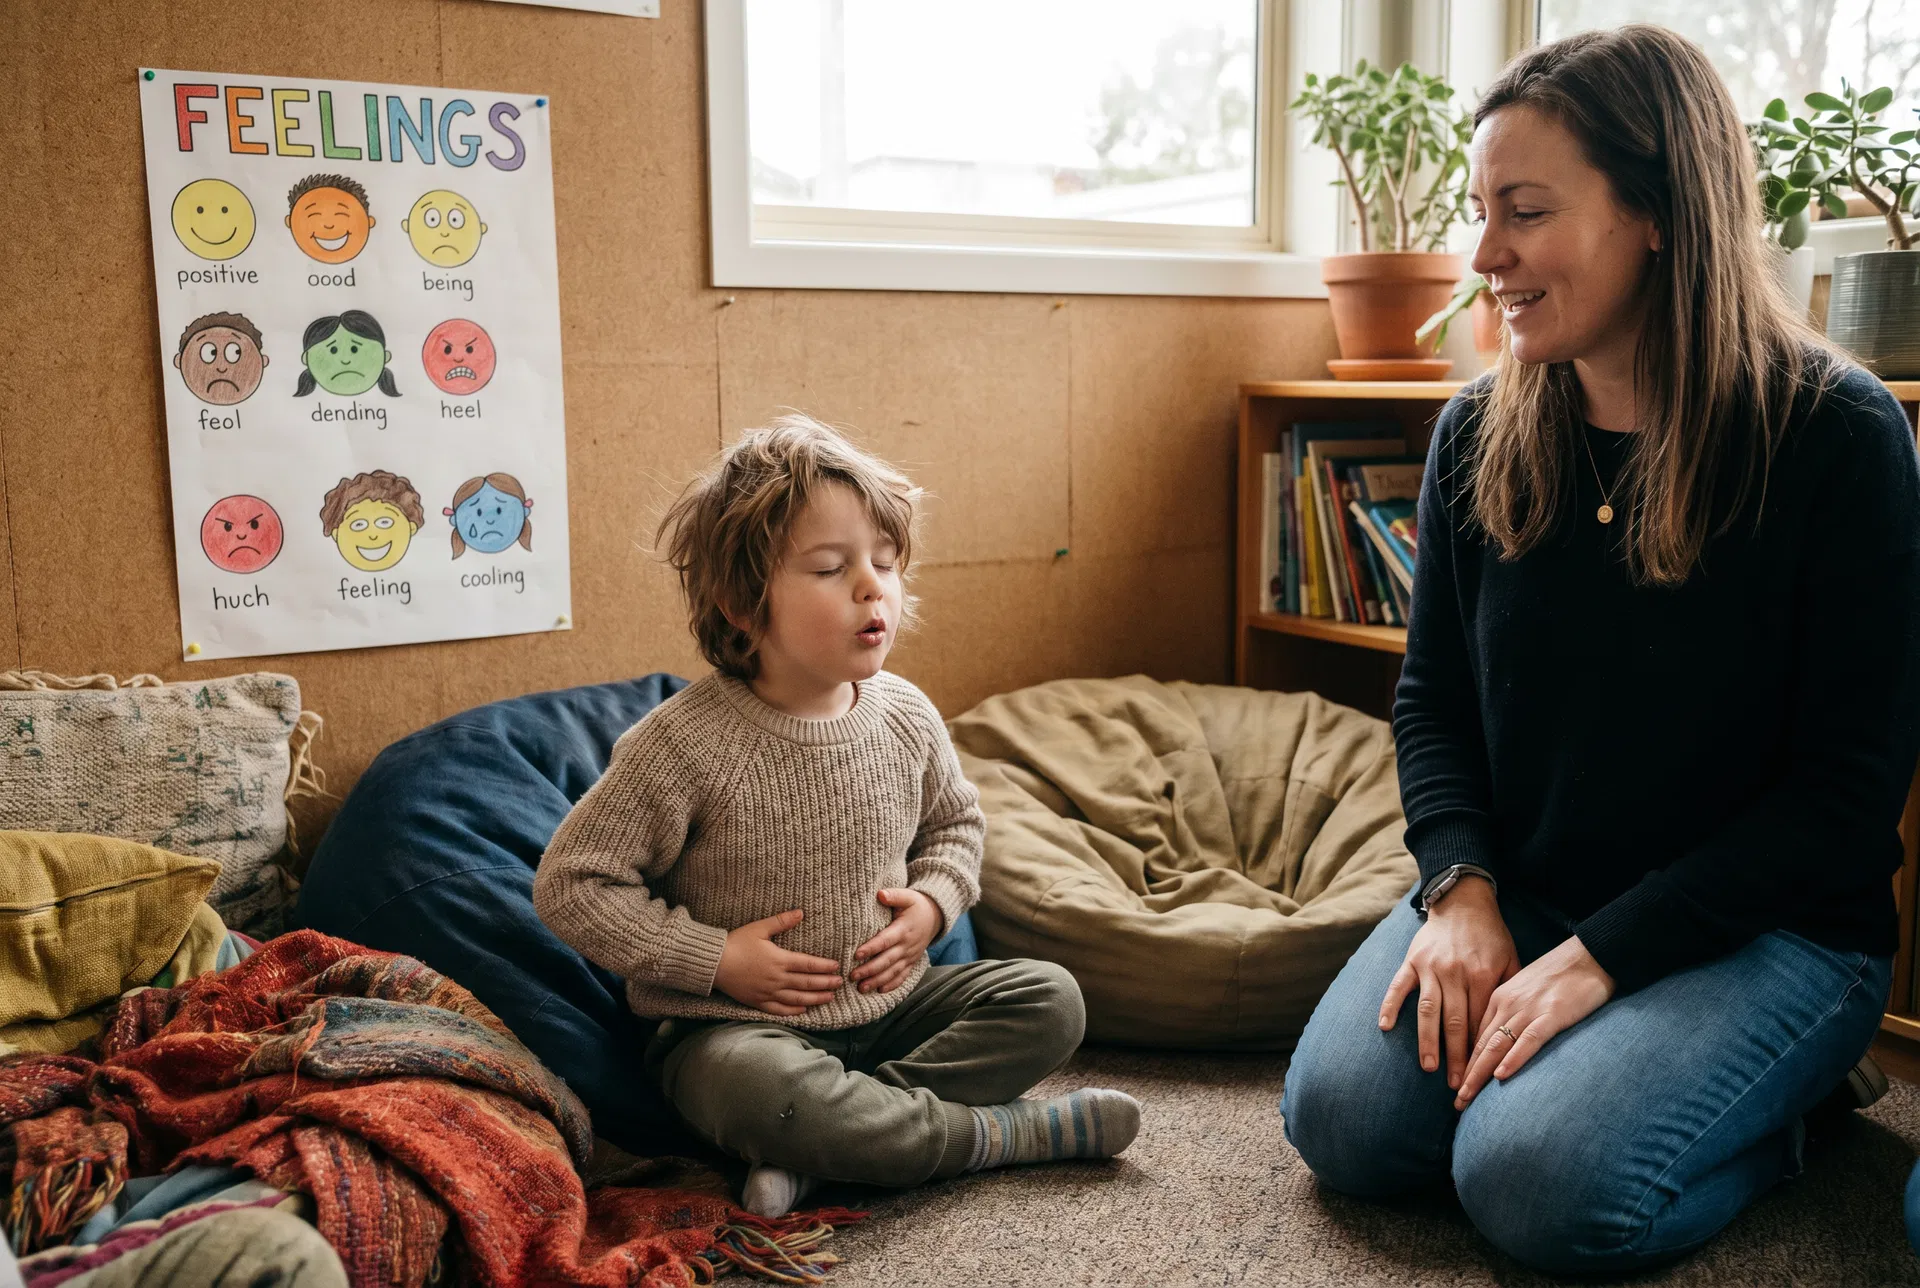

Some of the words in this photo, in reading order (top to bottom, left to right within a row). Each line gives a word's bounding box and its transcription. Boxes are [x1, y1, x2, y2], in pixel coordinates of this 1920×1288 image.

[173, 84, 526, 171] FEELINGS
[177, 264, 259, 290] positive
[307, 267, 356, 287] oood
[422, 272, 474, 301] being
[197, 409, 242, 431] feol
[311, 402, 388, 430] dending
[441, 400, 482, 419] heel
[337, 577, 412, 605] feeling
[460, 566, 525, 593] cooling
[212, 585, 270, 611] huch
